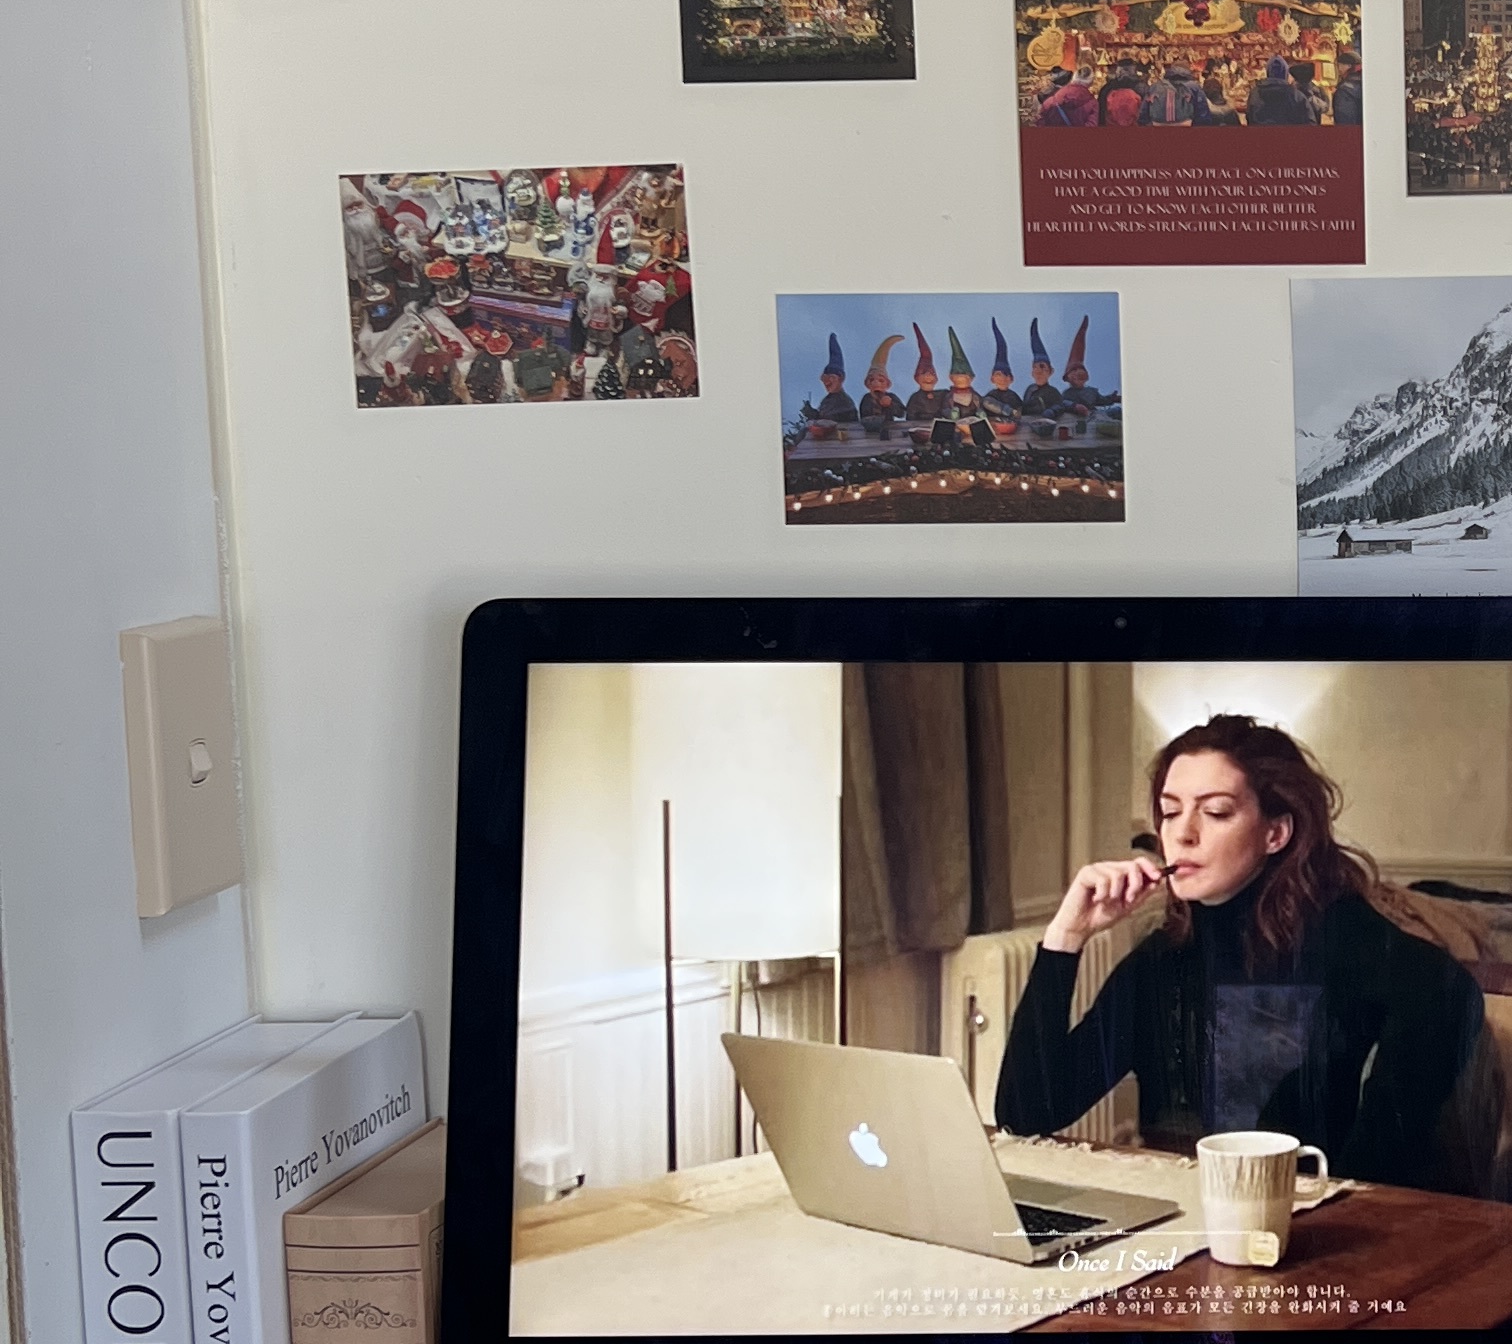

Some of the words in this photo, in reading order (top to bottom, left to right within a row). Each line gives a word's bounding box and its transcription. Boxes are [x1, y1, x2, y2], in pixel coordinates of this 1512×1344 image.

[274, 1151, 319, 1200] Pierre
[321, 1082, 412, 1166] Yovanovitch
[197, 1154, 226, 1261] Pierre
[1058, 1250, 1109, 1272] Once
[1115, 1250, 1126, 1271] I
[1131, 1247, 1177, 1271] Said
[1032, 1287, 1071, 1300] 영혼도
[1125, 1286, 1178, 1299] 순간으로
[1185, 1285, 1226, 1299] 수분을
[1232, 1285, 1300, 1299] 공급받아야
[1306, 1284, 1351, 1299] 합니다.
[1116, 1301, 1155, 1315] 음악의
[1162, 1301, 1201, 1314] 음표가
[1208, 1301, 1236, 1314] 모든
[1242, 1301, 1282, 1314] 긴장을
[1288, 1300, 1341, 1314] 완화시켜
[1348, 1300, 1360, 1314] 줄
[1367, 1300, 1407, 1314] 거예요
